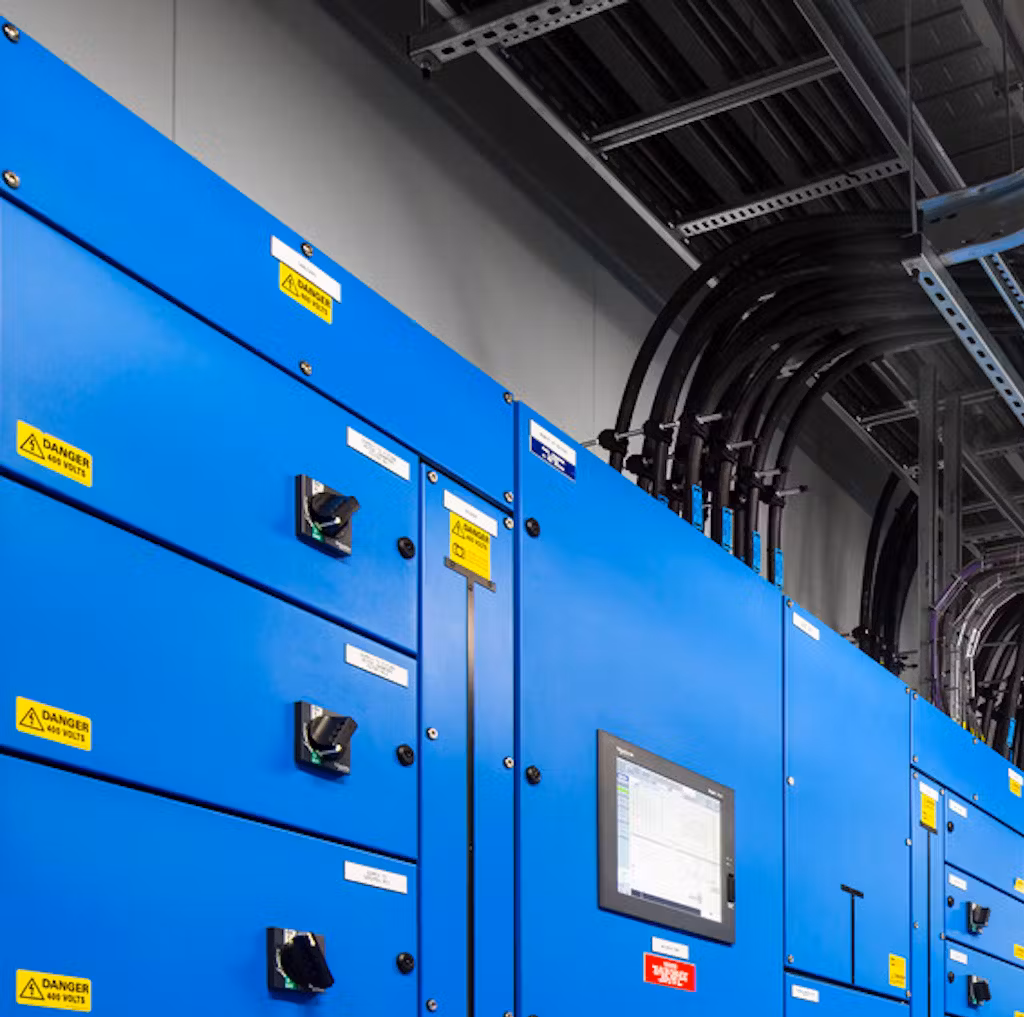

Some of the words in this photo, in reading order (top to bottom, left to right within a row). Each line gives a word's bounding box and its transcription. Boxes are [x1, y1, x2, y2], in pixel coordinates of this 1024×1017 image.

[297, 278, 331, 308] DANGER
[43, 437, 89, 468] DANGER
[47, 454, 61, 467] 400
[63, 460, 86, 478] VOLTS
[463, 523, 489, 543] DANGER
[42, 710, 89, 733] DANGER
[46, 724, 61, 735] 400
[63, 729, 85, 742] VOLTS
[42, 978, 89, 995] DANGER
[47, 992, 61, 1001] 400
[63, 993, 85, 1004] VOLTS
